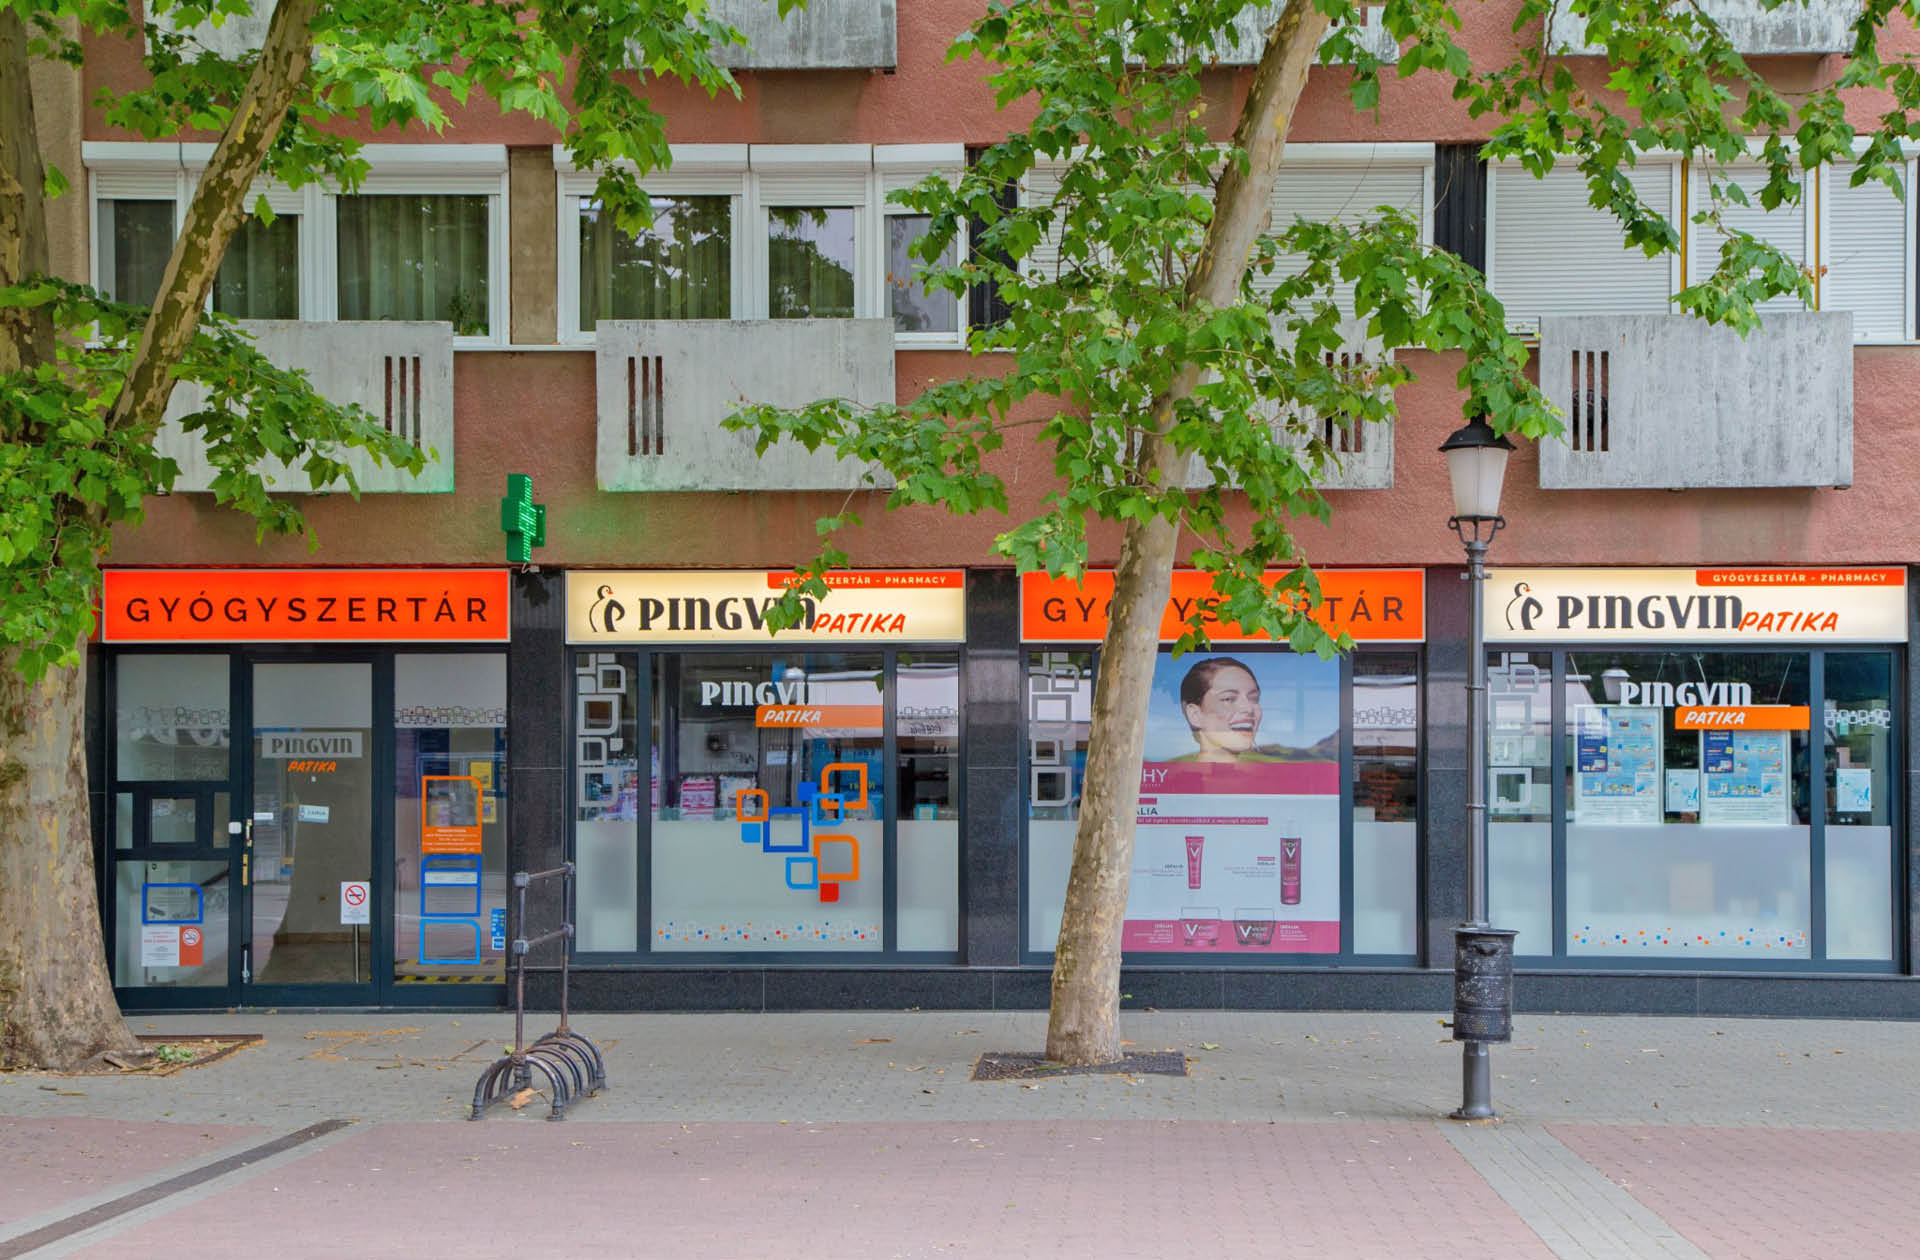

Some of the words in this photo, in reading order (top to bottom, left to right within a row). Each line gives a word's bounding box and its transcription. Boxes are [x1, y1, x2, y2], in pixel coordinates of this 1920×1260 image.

[886, 576, 946, 585] PHARMACY
[1713, 572, 1805, 583] GYÓGYSZERTÁR
[1821, 573, 1886, 583] PHARMACY
[127, 592, 486, 621] GYÓGYSZERTÁR
[1557, 596, 1743, 629] PINGVIN
[811, 613, 906, 633] PATIKA
[1738, 611, 1839, 632] PATIKA
[1620, 682, 1751, 706] PINGVIN
[763, 710, 822, 723] PATIKA
[1684, 712, 1746, 725] PATIKA
[271, 738, 352, 754] PINGVIN
[287, 760, 337, 773] PATIKA
